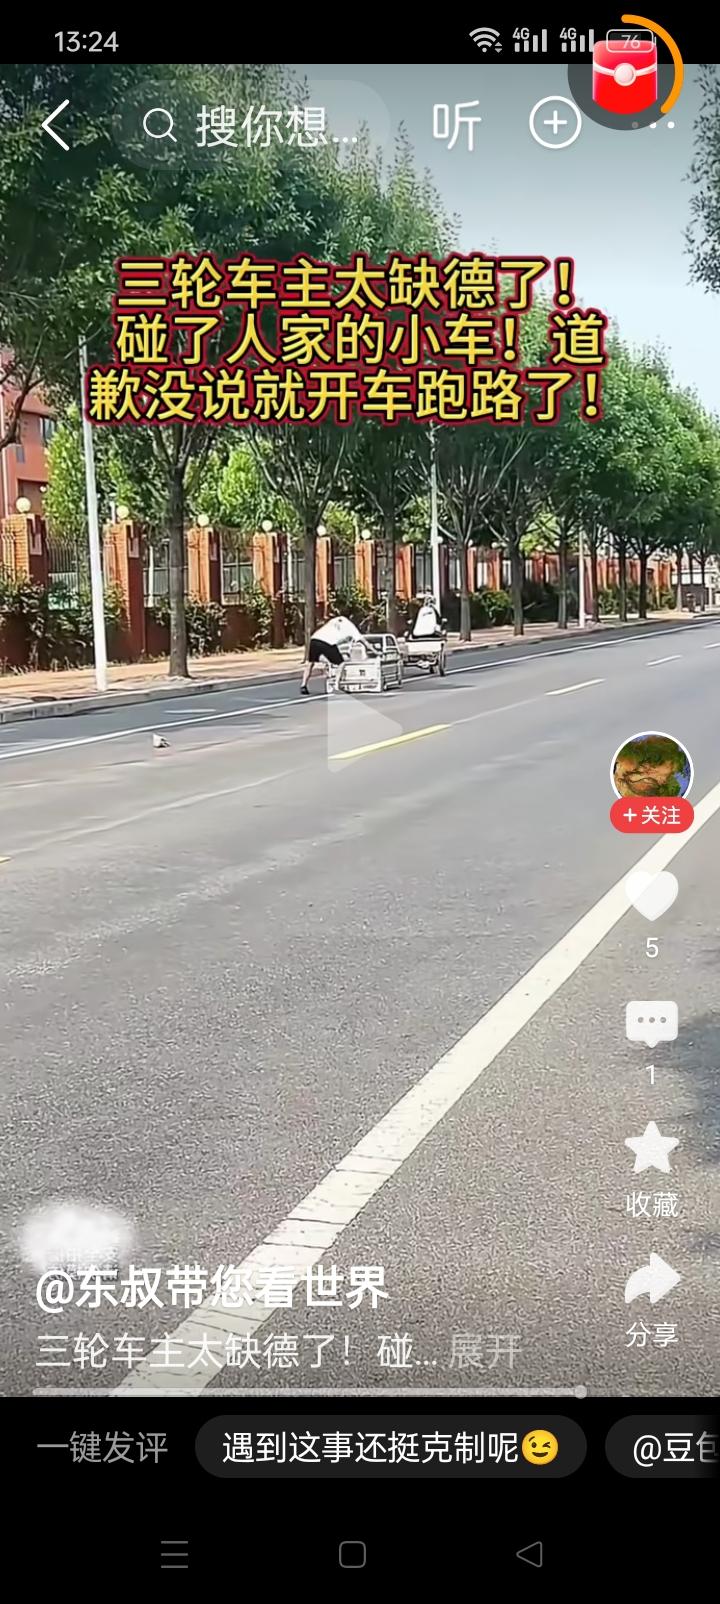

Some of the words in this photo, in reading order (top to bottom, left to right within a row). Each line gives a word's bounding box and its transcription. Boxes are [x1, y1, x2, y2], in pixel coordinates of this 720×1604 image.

[55, 31, 118, 52] 13:24
[513, 28, 529, 39] 4G
[560, 28, 576, 39] 4G
[621, 34, 640, 49] 76
[432, 101, 481, 152] 听
[645, 938, 659, 957] 5
[646, 1065, 655, 1084] 1
[626, 1192, 678, 1217] 收藏
[35, 1265, 390, 1312] @东叔带您看世界
[626, 1322, 678, 1347] 分享
[450, 1334, 522, 1369] 展开
[37, 1431, 168, 1463] 一键发评
[223, 1431, 518, 1464] 遇到这事还挺克制呢
